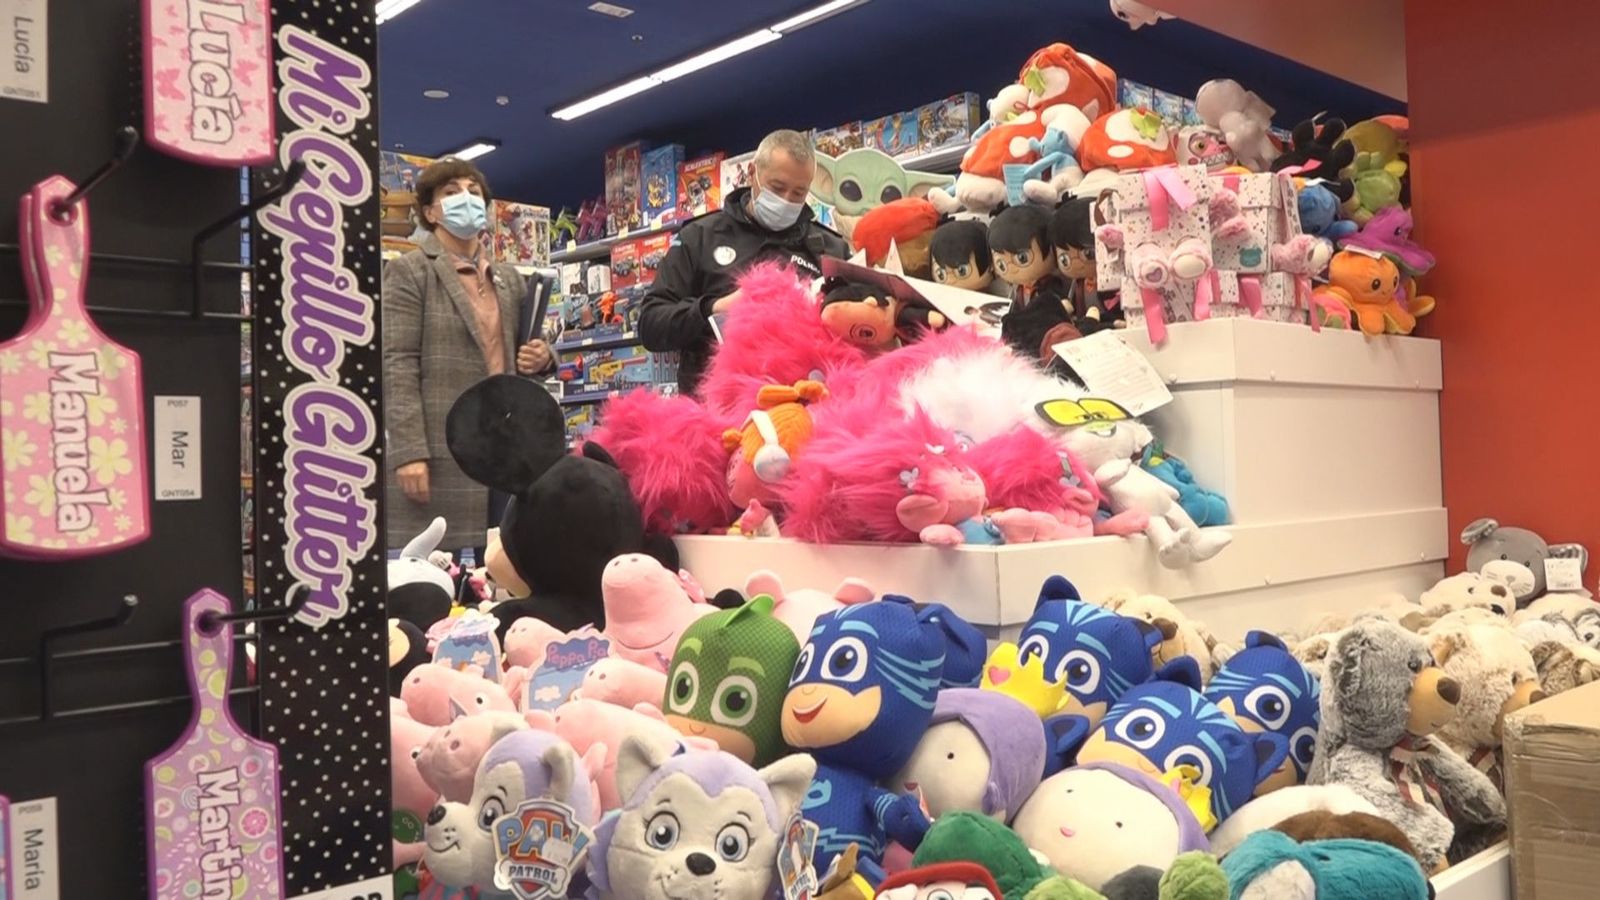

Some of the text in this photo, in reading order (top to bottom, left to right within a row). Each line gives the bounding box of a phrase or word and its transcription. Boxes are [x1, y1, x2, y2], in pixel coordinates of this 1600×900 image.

[14, 16, 35, 73] Lucía
[187, 0, 247, 144] Lucía
[261, 28, 372, 624] Mi Cepillo Glitter
[47, 351, 111, 532] Manuela
[171, 430, 188, 468] Mar
[547, 643, 585, 668] Peppa
[24, 828, 45, 890] María
[508, 865, 558, 884] PATROL
